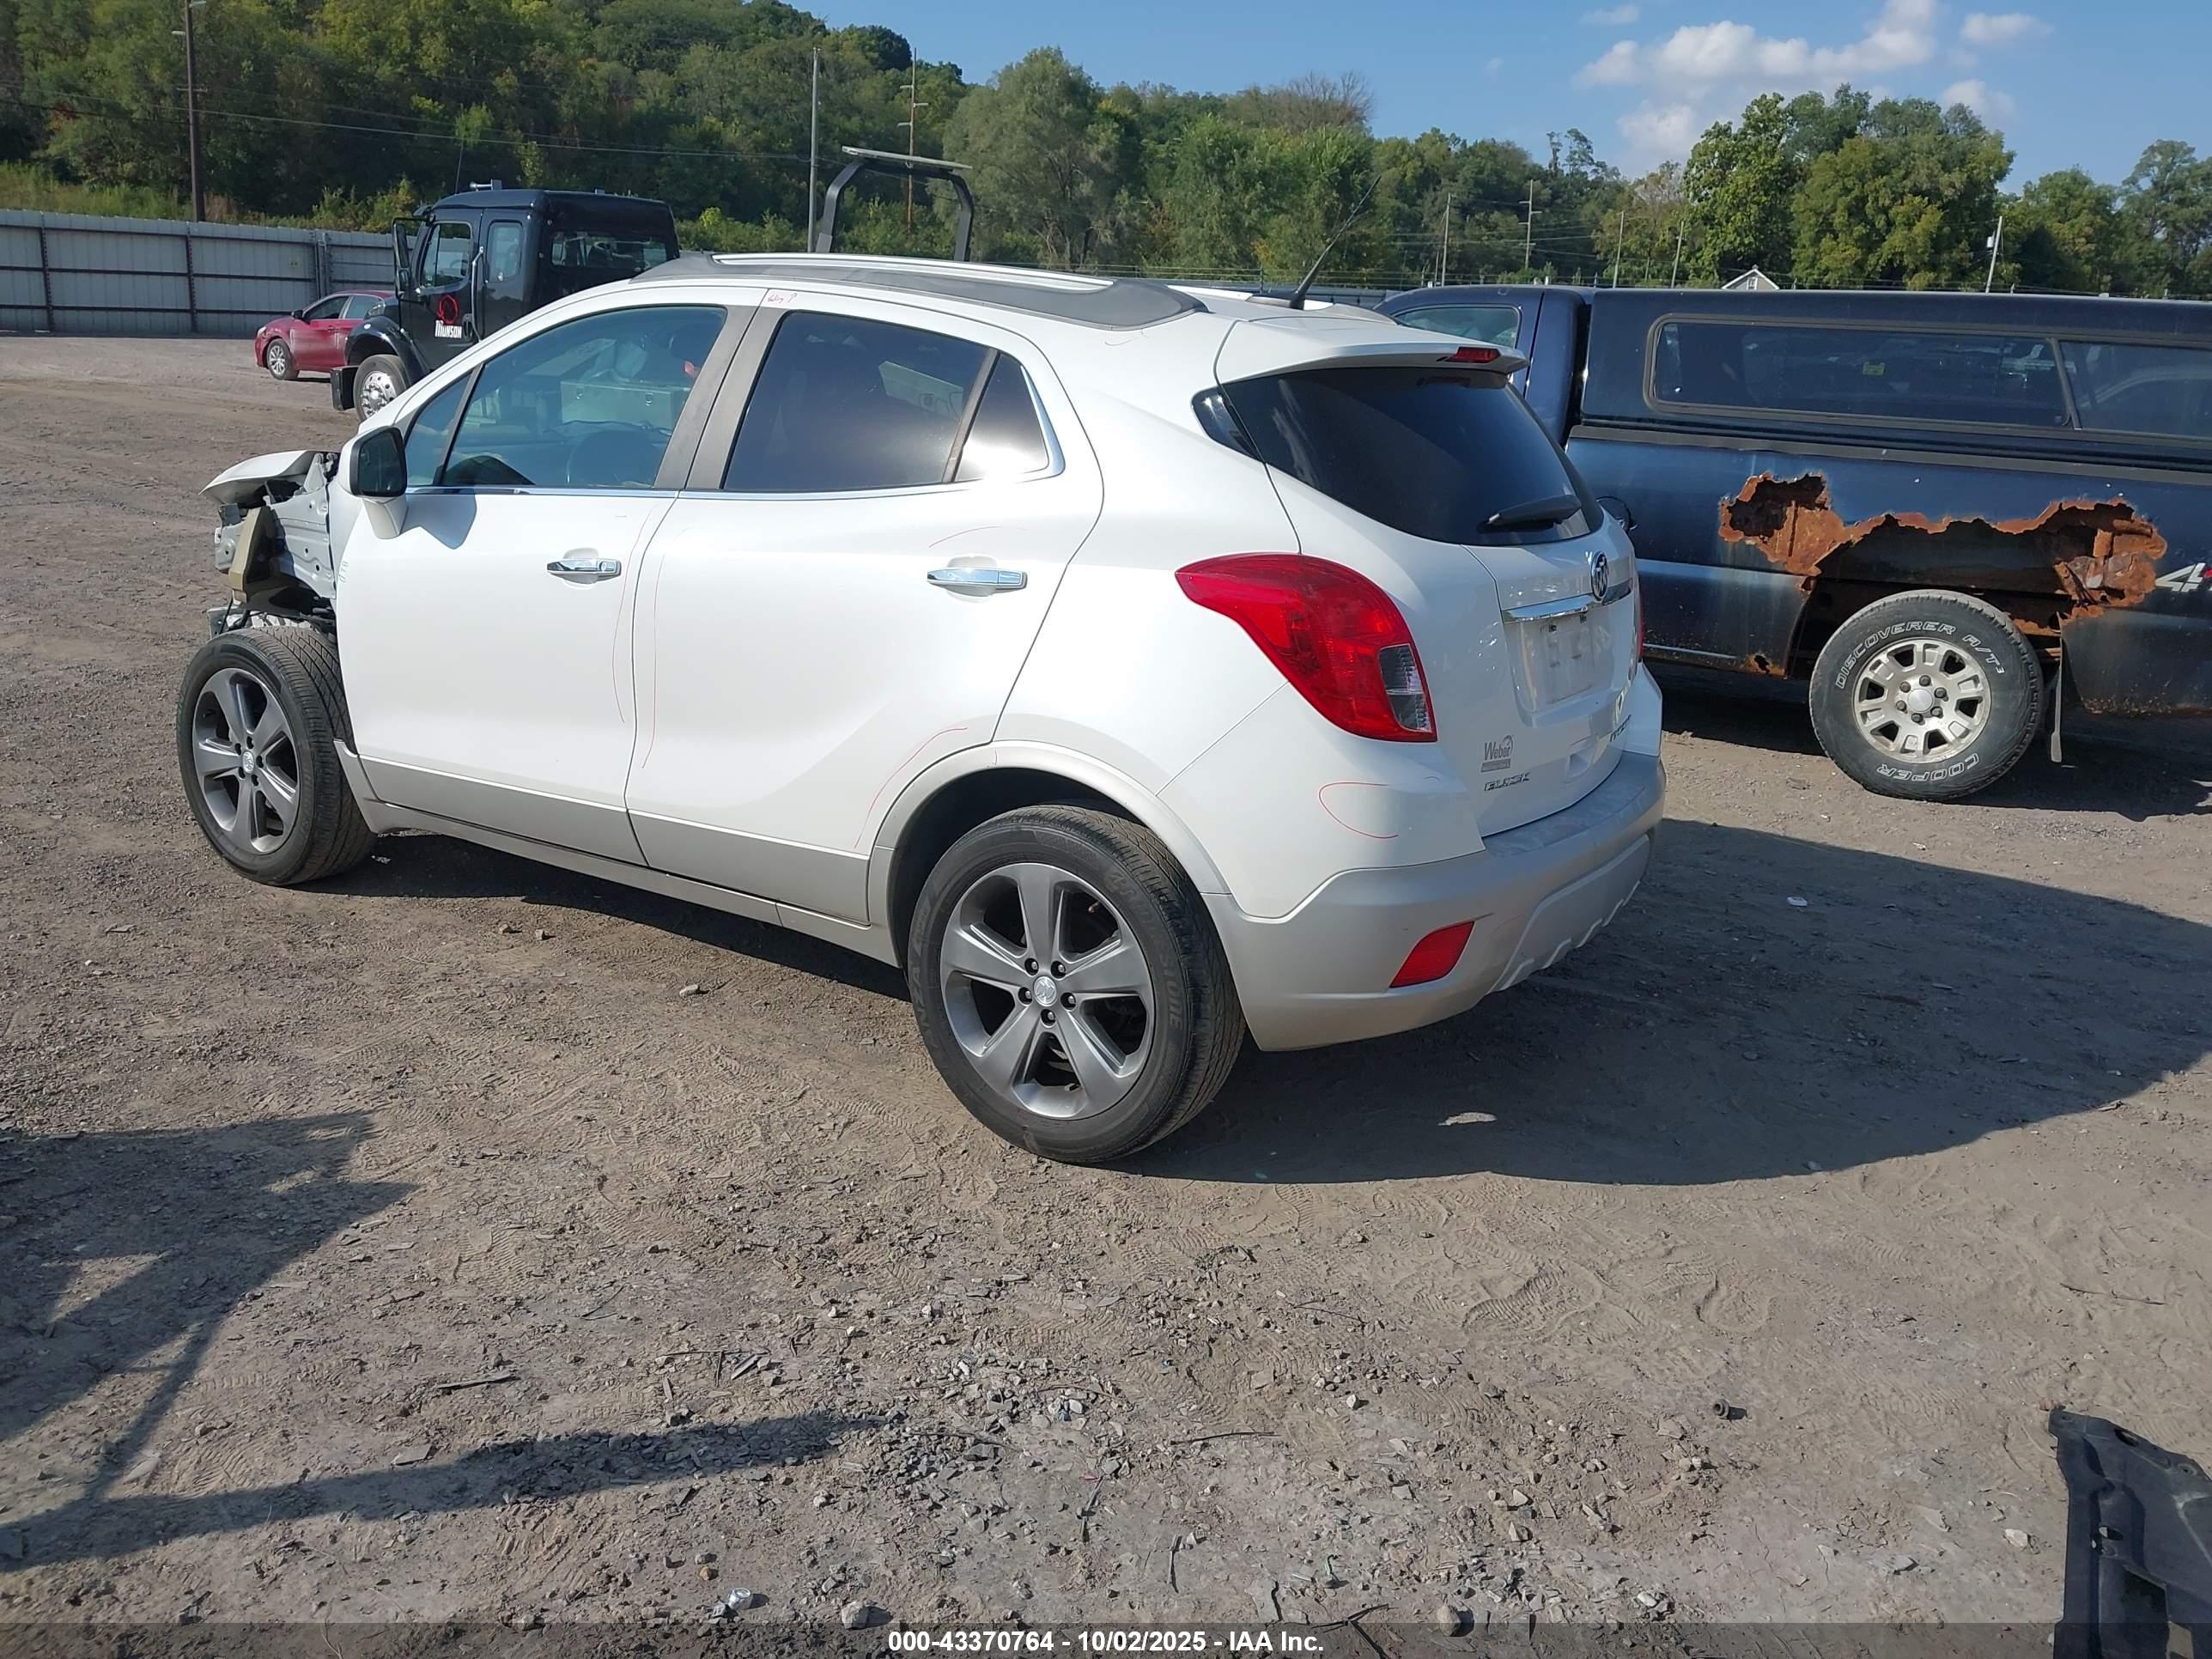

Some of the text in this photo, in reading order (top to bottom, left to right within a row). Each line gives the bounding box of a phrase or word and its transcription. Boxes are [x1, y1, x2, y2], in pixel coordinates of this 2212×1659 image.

[434, 319, 462, 338] MUNSON
[2154, 562, 2212, 592] 4
[1835, 621, 1956, 690] DISCOVERER
[1876, 752, 1980, 782] COOPER
